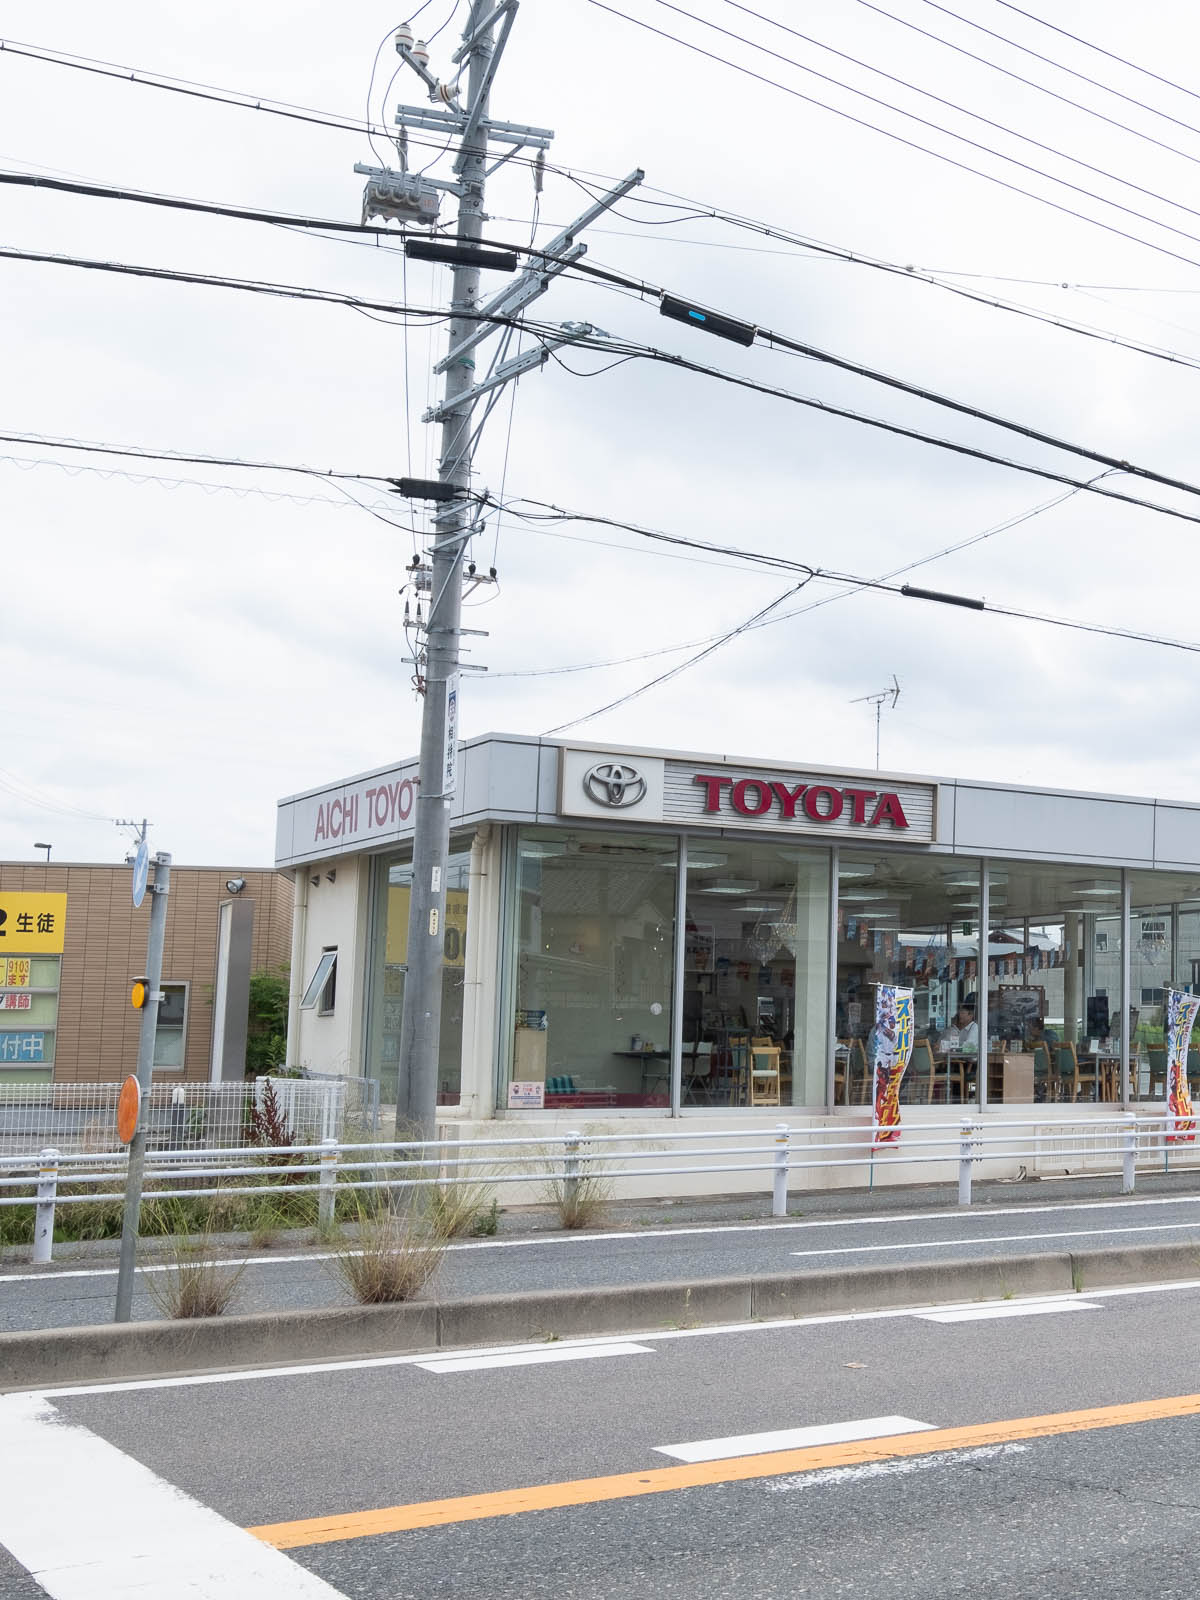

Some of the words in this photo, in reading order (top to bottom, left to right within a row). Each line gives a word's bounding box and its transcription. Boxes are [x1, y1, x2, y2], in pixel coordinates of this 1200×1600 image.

[314, 793, 359, 842] AICHI
[365, 775, 421, 829] TOYO
[693, 774, 911, 829] TOYOTA
[15, 912, 55, 934] 生徒
